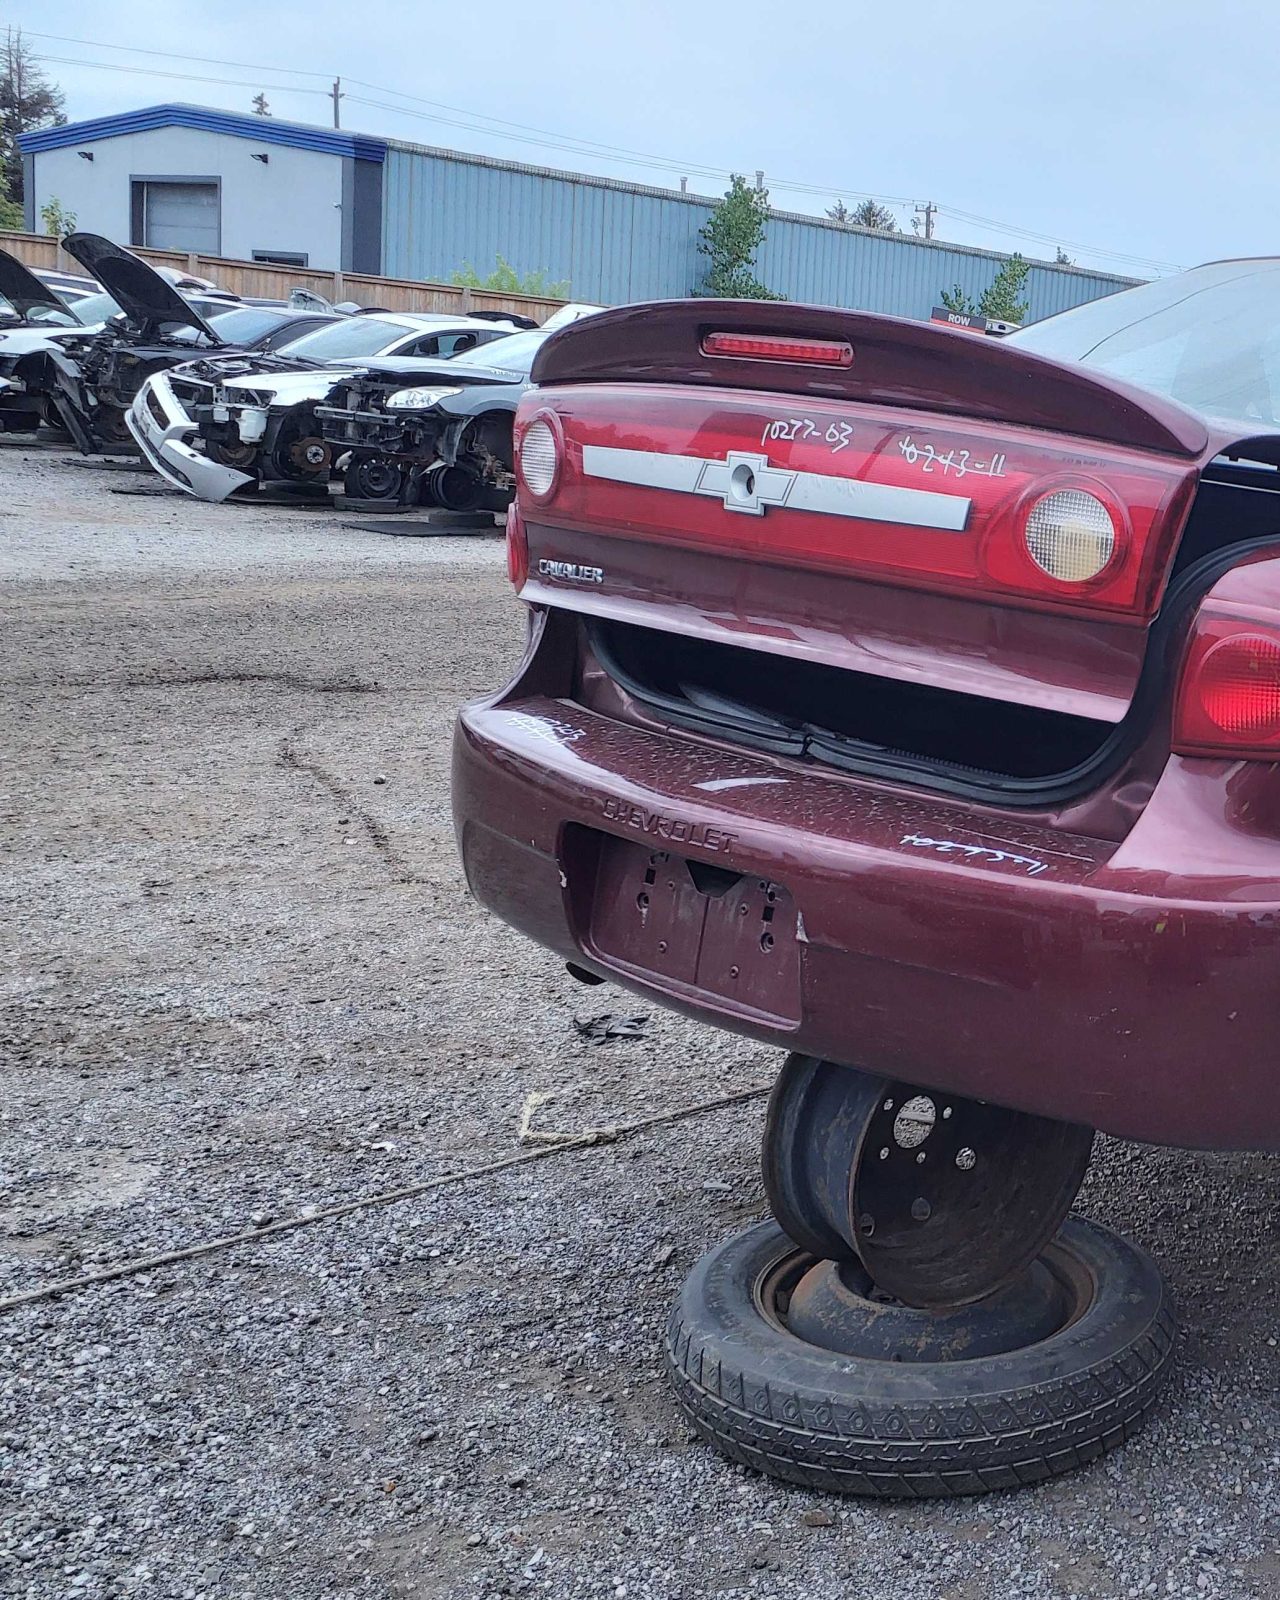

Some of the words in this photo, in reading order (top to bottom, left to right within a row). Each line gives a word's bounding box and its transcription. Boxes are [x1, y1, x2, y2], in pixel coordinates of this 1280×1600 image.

[947, 313, 970, 327] ROW
[760, 418, 853, 454] 10277-03
[538, 558, 604, 585] CAVALIER
[602, 799, 739, 853] CHEVROLET
